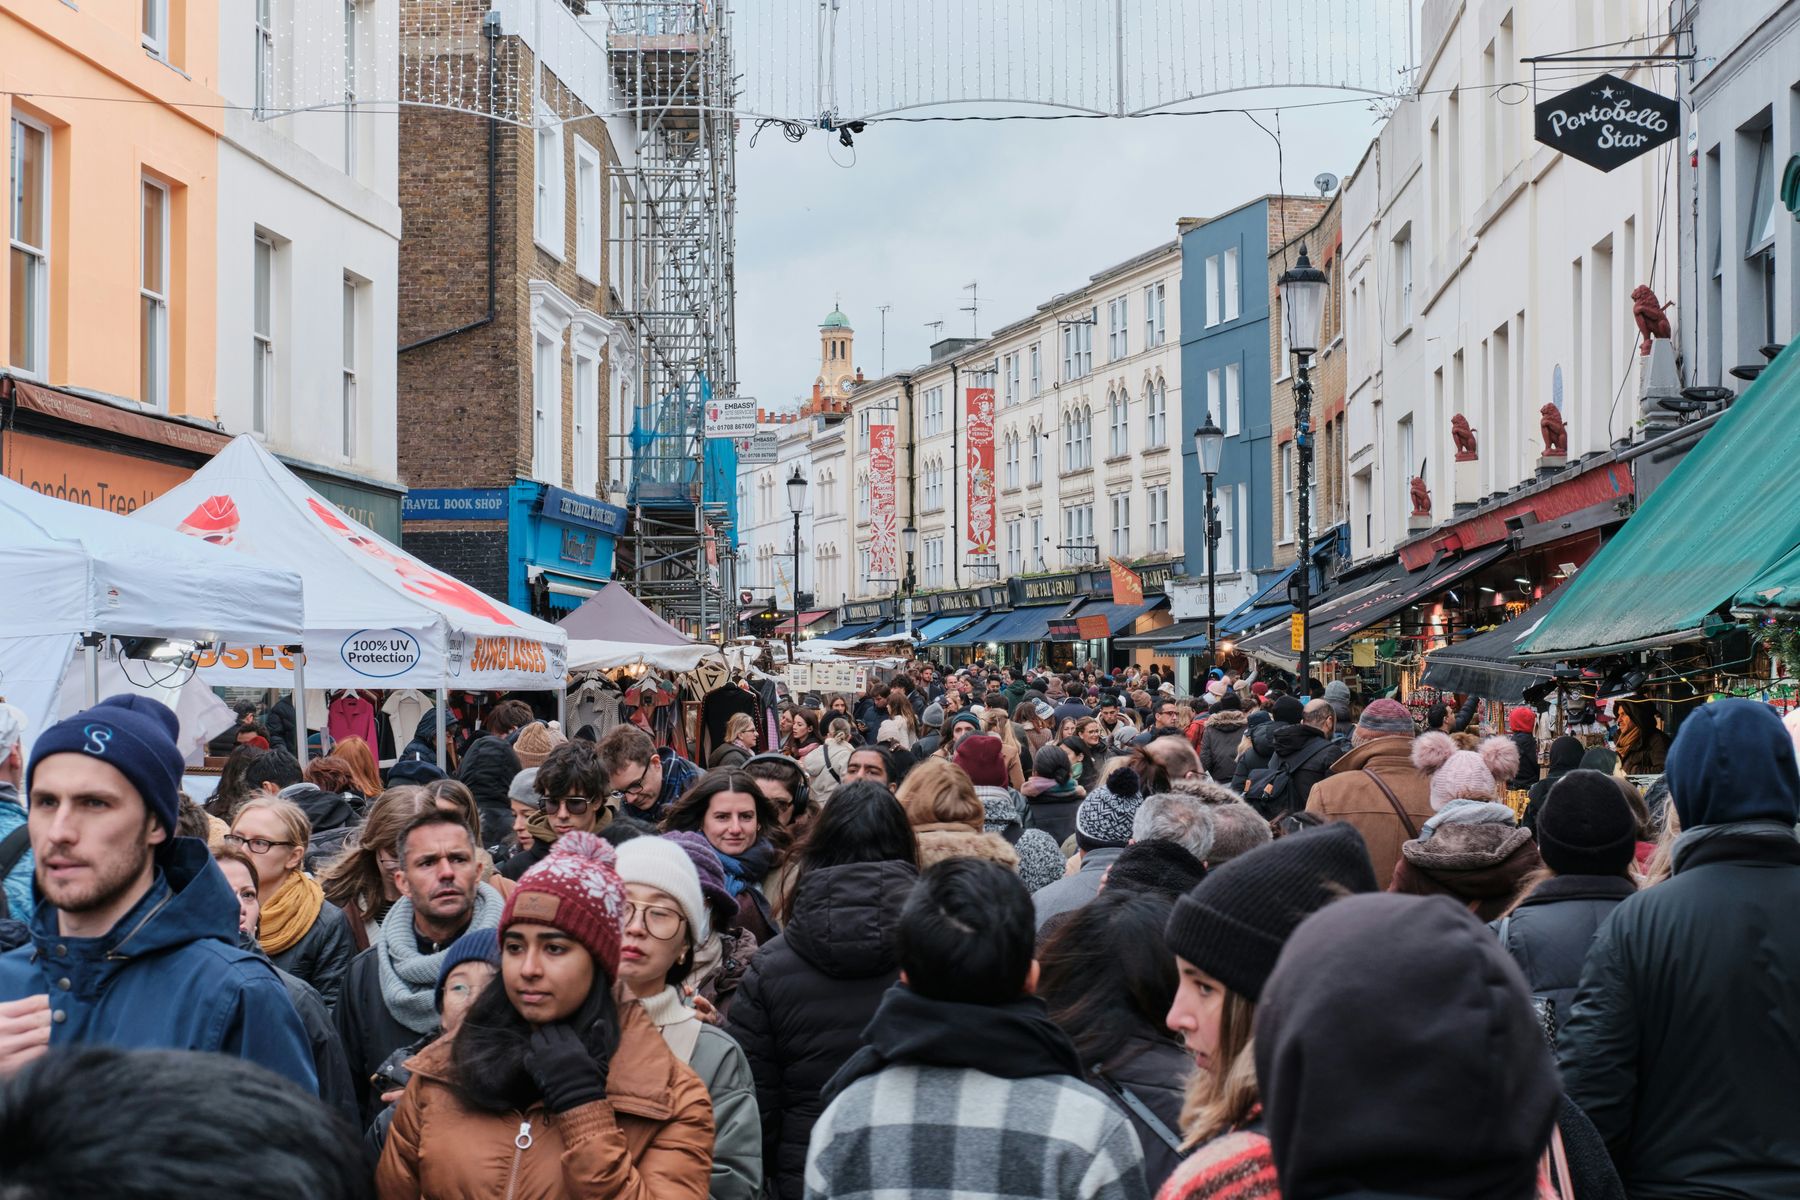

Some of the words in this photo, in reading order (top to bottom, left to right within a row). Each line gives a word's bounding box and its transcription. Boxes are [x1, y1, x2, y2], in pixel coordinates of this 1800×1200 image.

[1548, 100, 1668, 137] Portobello
[1598, 124, 1648, 149] Star
[724, 402, 755, 410] EMBASSY
[401, 498, 440, 510] TRAVEL
[444, 498, 473, 510] BOOK
[474, 498, 503, 510] SHOP
[353, 640, 387, 651] 100%
[390, 640, 410, 651] UV
[348, 652, 414, 663] Protection
[471, 636, 547, 673] SUNGLASSES
